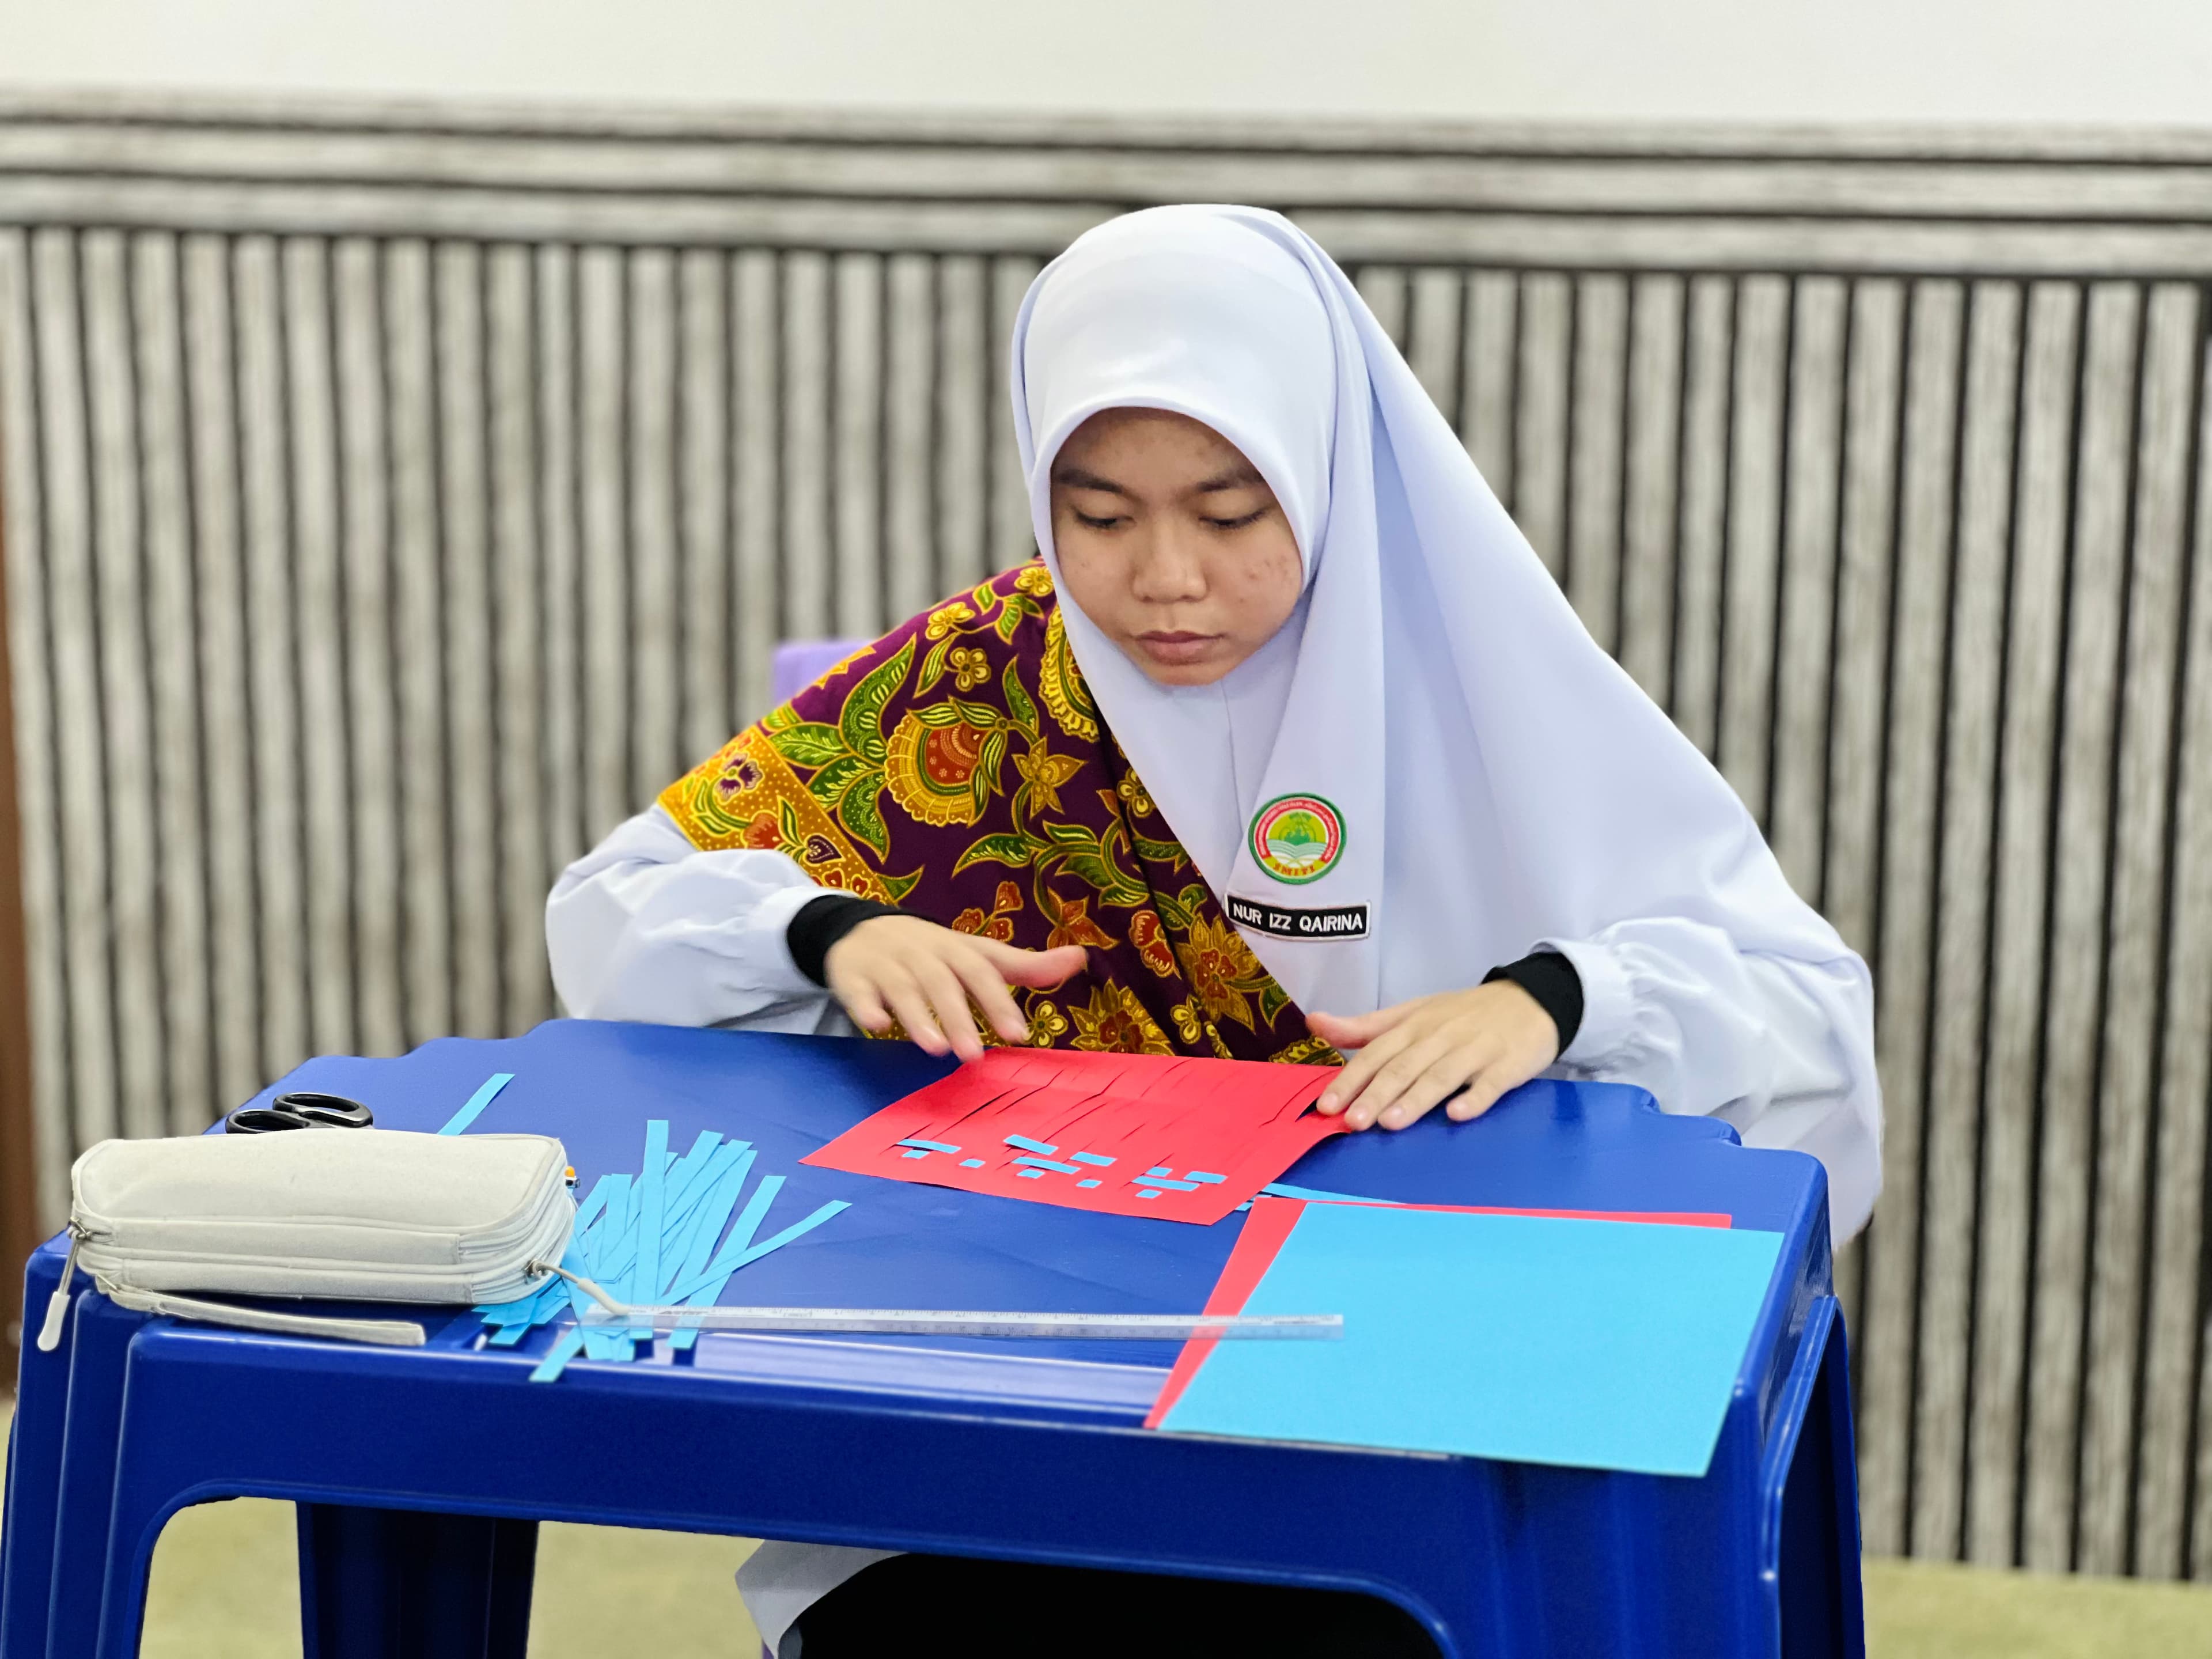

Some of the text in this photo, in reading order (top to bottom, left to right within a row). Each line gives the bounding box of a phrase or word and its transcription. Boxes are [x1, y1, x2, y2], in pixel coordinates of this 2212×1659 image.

[1233, 902, 1363, 933] NUR IZZ QAIRINA
